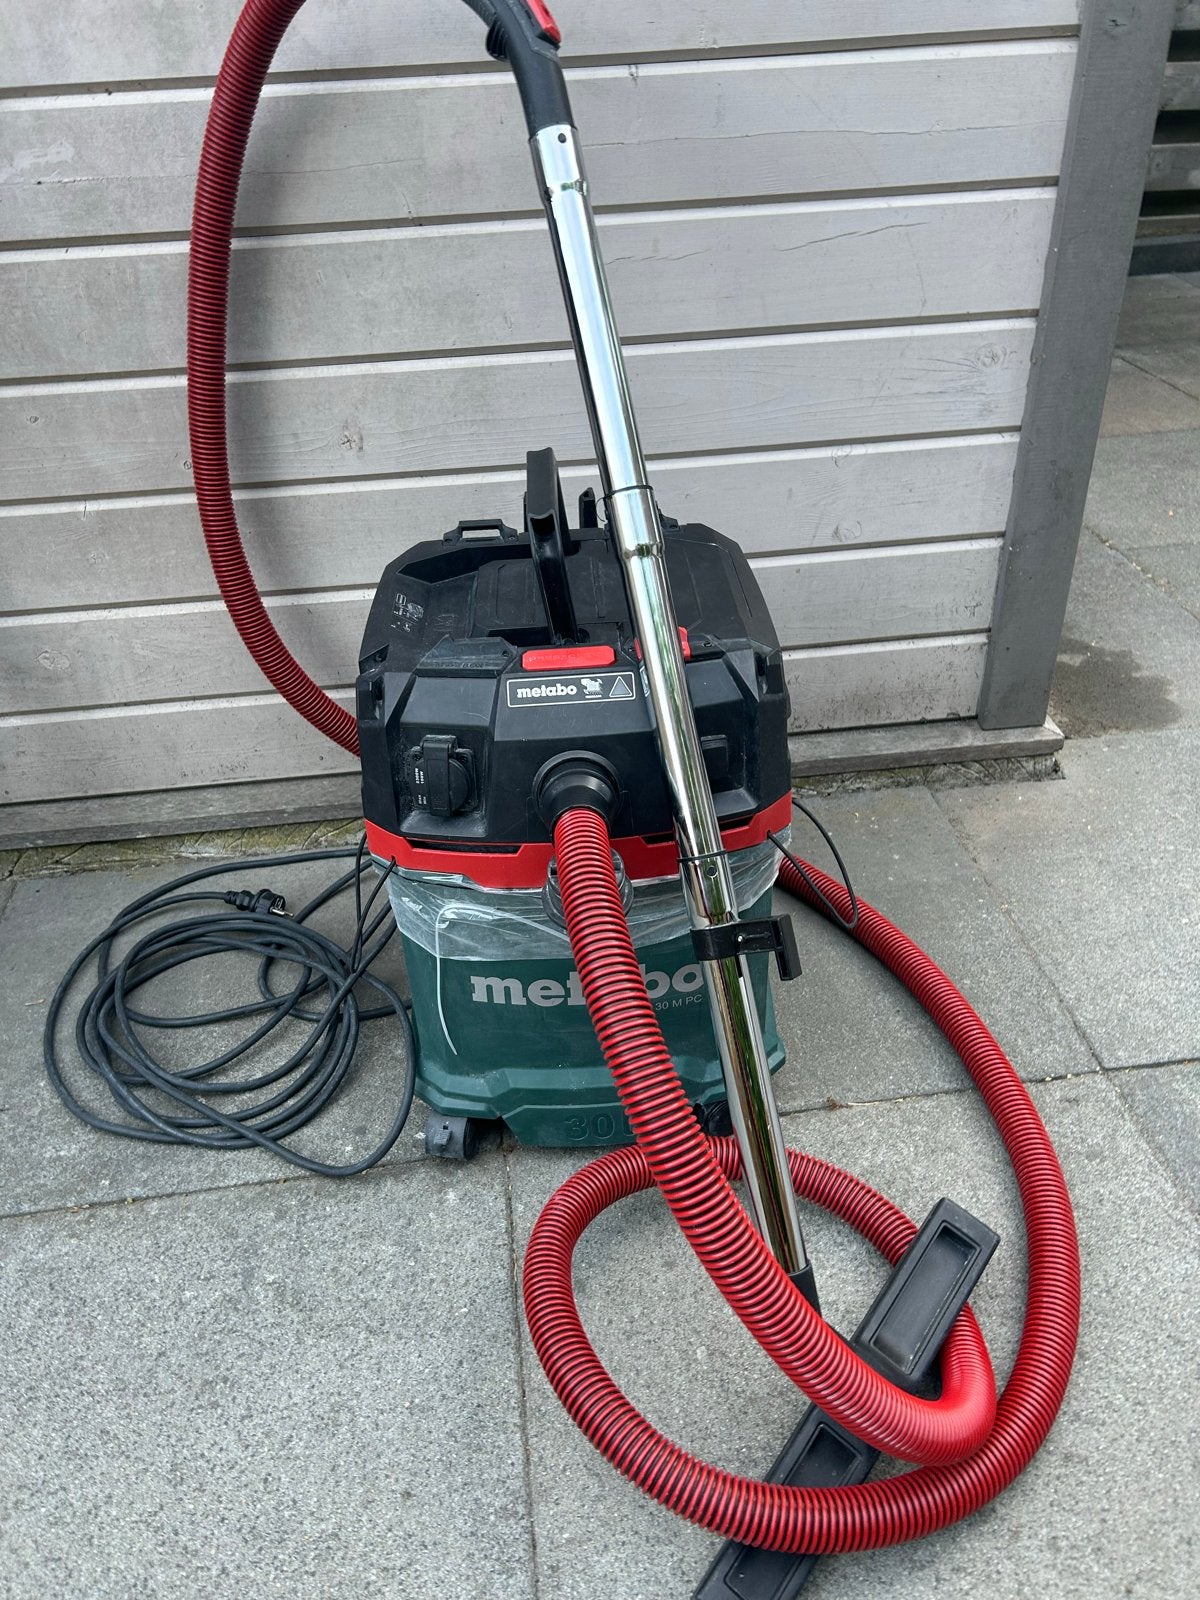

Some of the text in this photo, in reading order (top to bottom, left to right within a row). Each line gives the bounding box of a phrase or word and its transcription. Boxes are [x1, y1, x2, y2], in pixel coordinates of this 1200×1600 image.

[516, 683, 577, 698] metabo
[470, 963, 704, 1007] metbo
[655, 994, 703, 1011] 30 M PC
